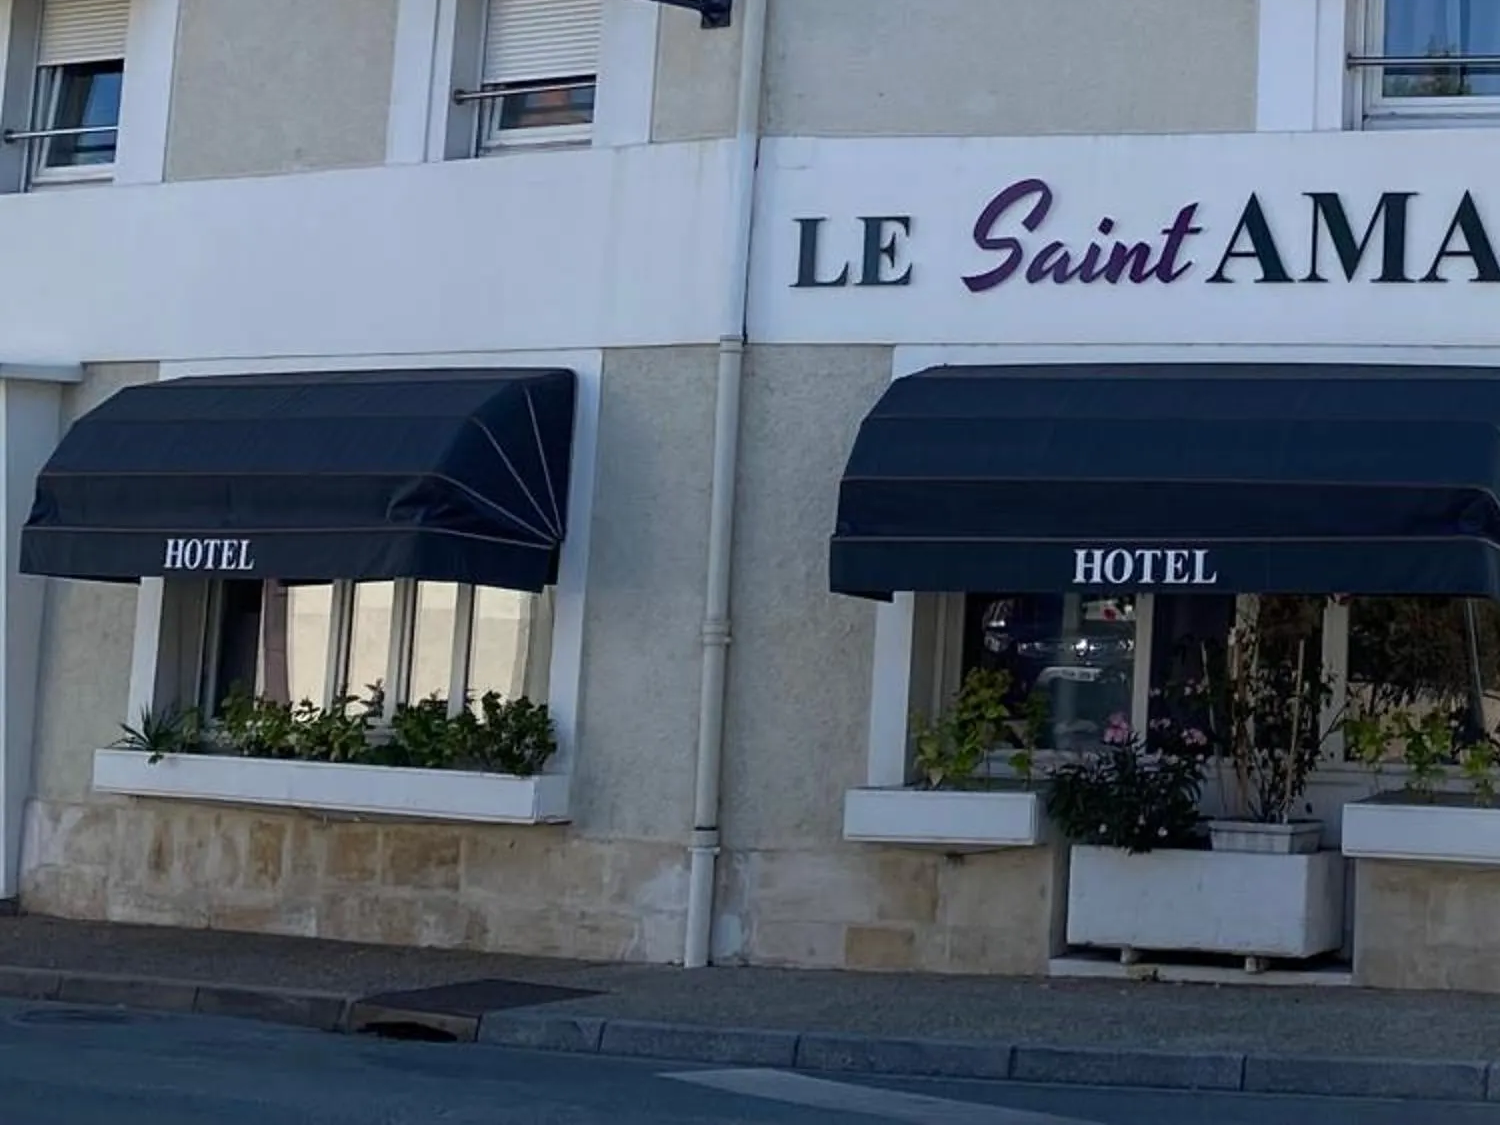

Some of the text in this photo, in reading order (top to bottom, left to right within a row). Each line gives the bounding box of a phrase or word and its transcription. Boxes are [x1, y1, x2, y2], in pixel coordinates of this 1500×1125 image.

[788, 214, 914, 288] LE
[960, 177, 1203, 293] Saint
[163, 538, 255, 570] HOTEL
[1072, 548, 1217, 584] HOTEL
